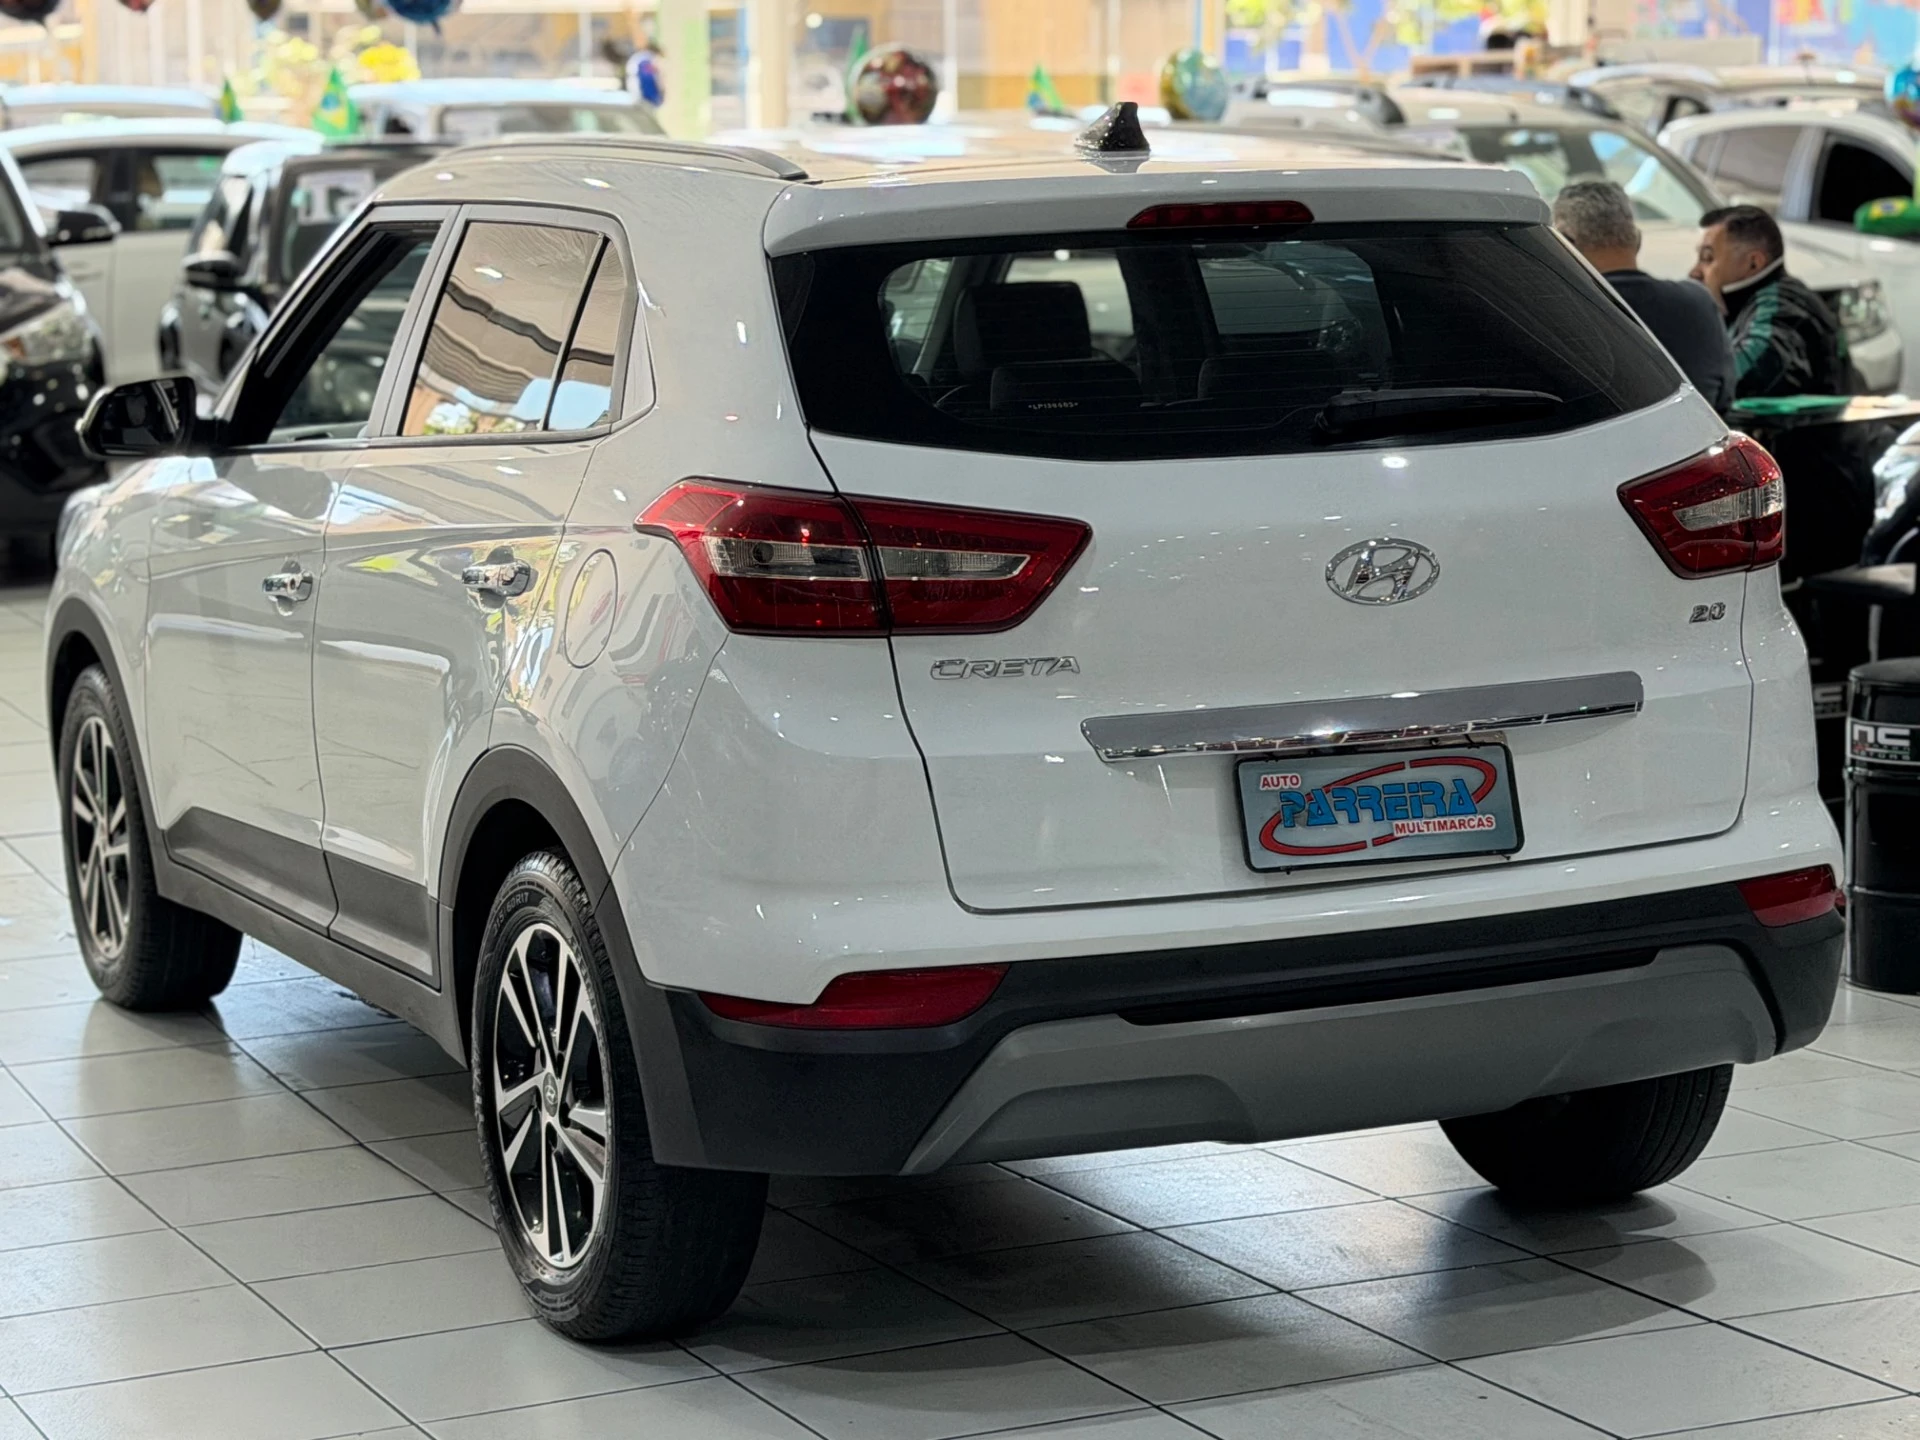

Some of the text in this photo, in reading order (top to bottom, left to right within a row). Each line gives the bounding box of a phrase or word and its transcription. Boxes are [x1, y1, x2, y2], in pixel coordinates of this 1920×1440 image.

[930, 656, 1081, 680] CRETA
[1260, 774, 1300, 789] AUTO
[1279, 778, 1478, 828] PARREIRA
[1394, 816, 1495, 835] MULTIMARCAS
